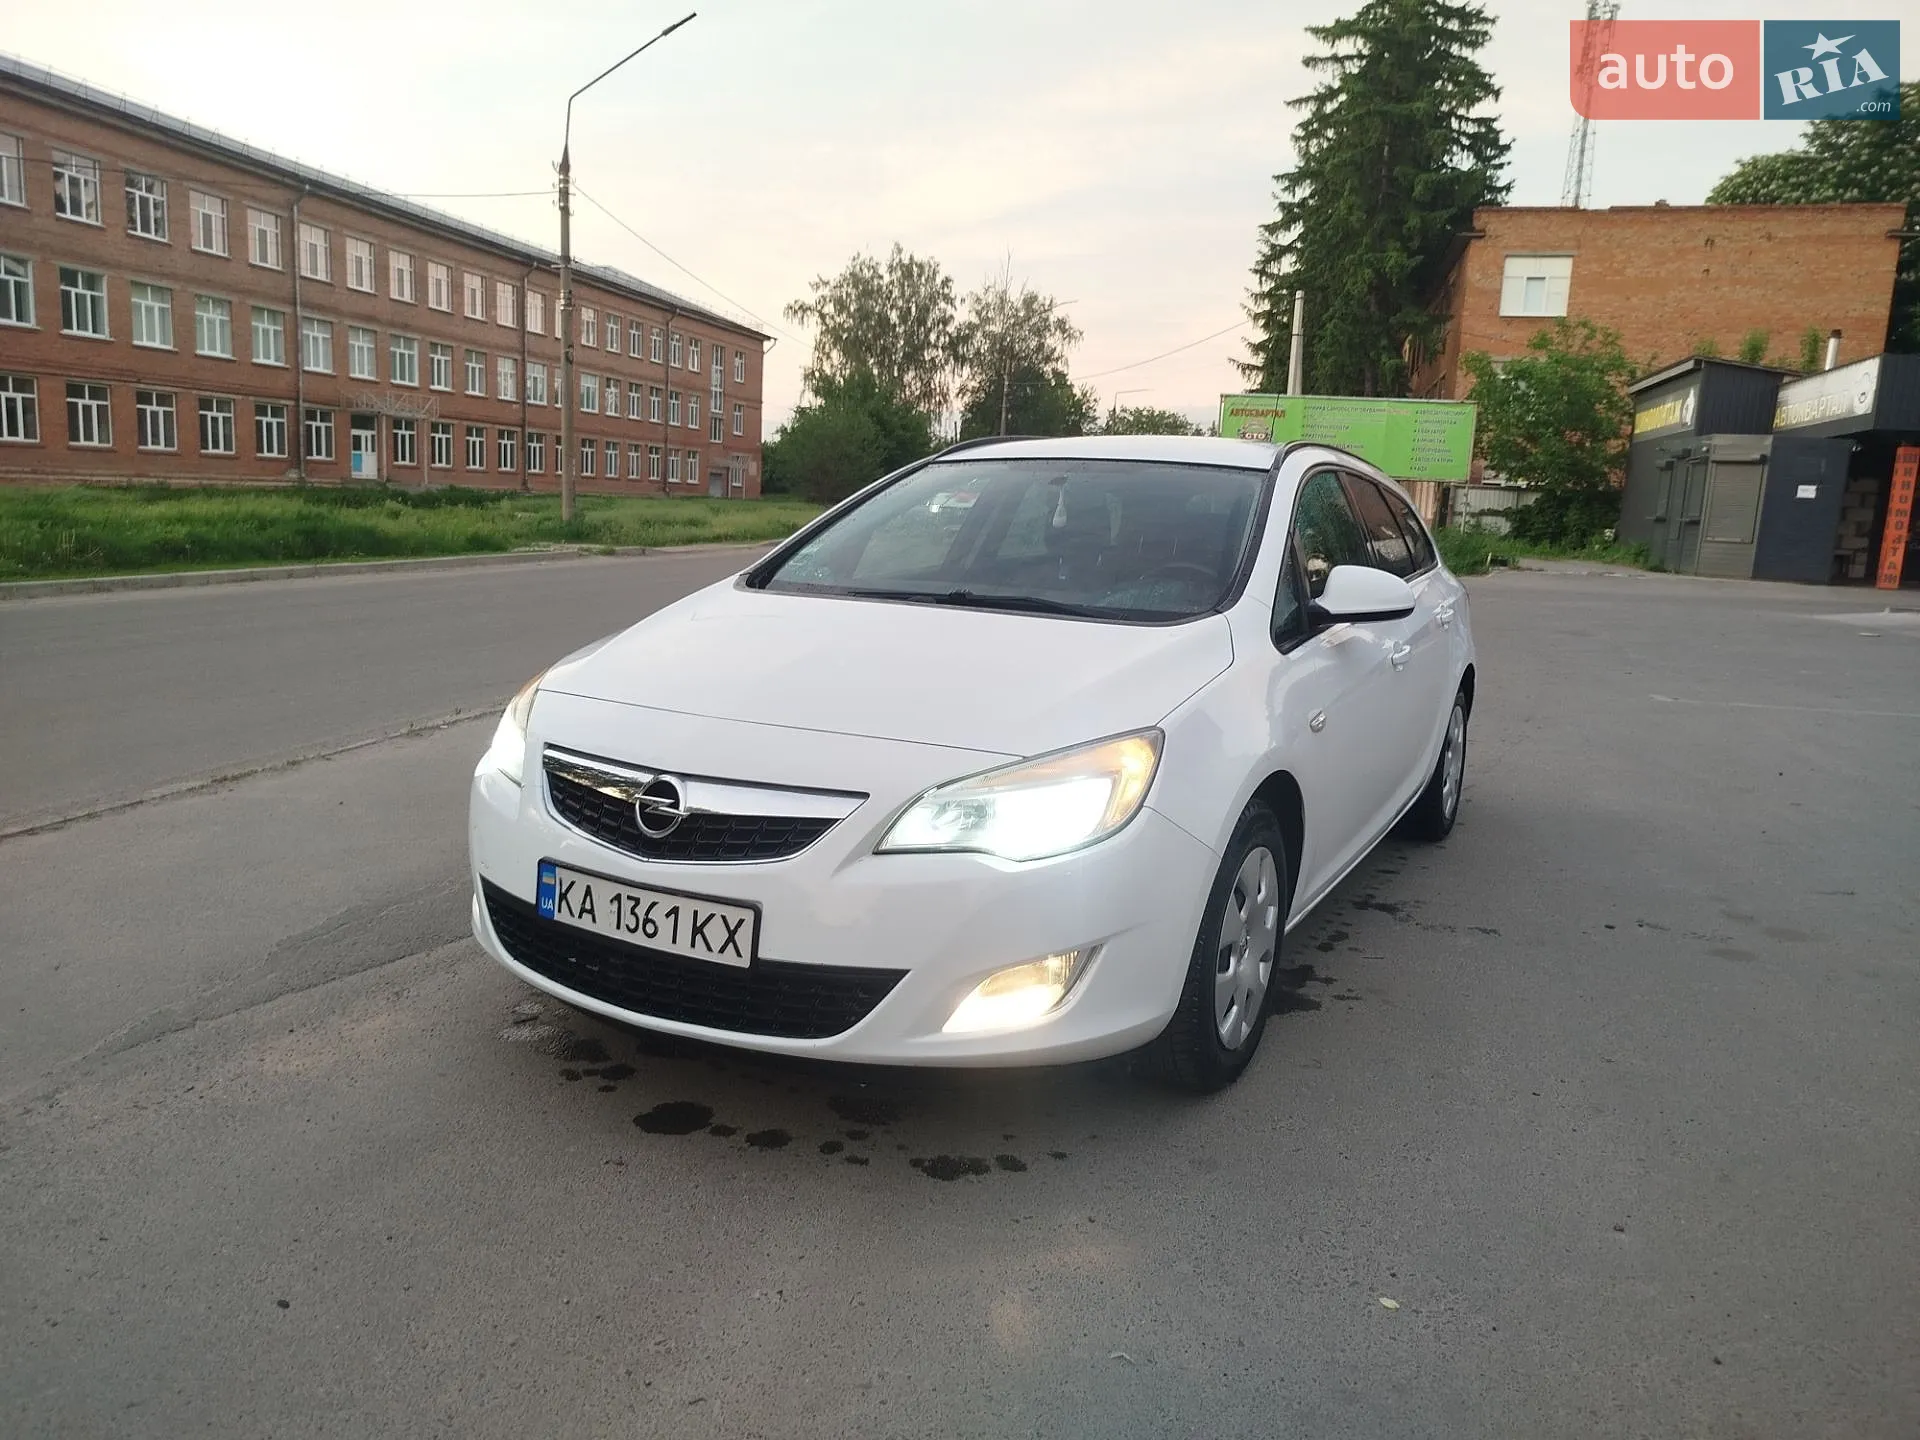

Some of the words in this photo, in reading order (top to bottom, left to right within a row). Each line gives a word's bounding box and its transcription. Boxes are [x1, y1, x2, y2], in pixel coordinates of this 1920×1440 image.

[541, 898, 554, 911] UA
[557, 877, 597, 924] KA
[609, 892, 680, 945] 1361
[690, 909, 746, 958] KX
